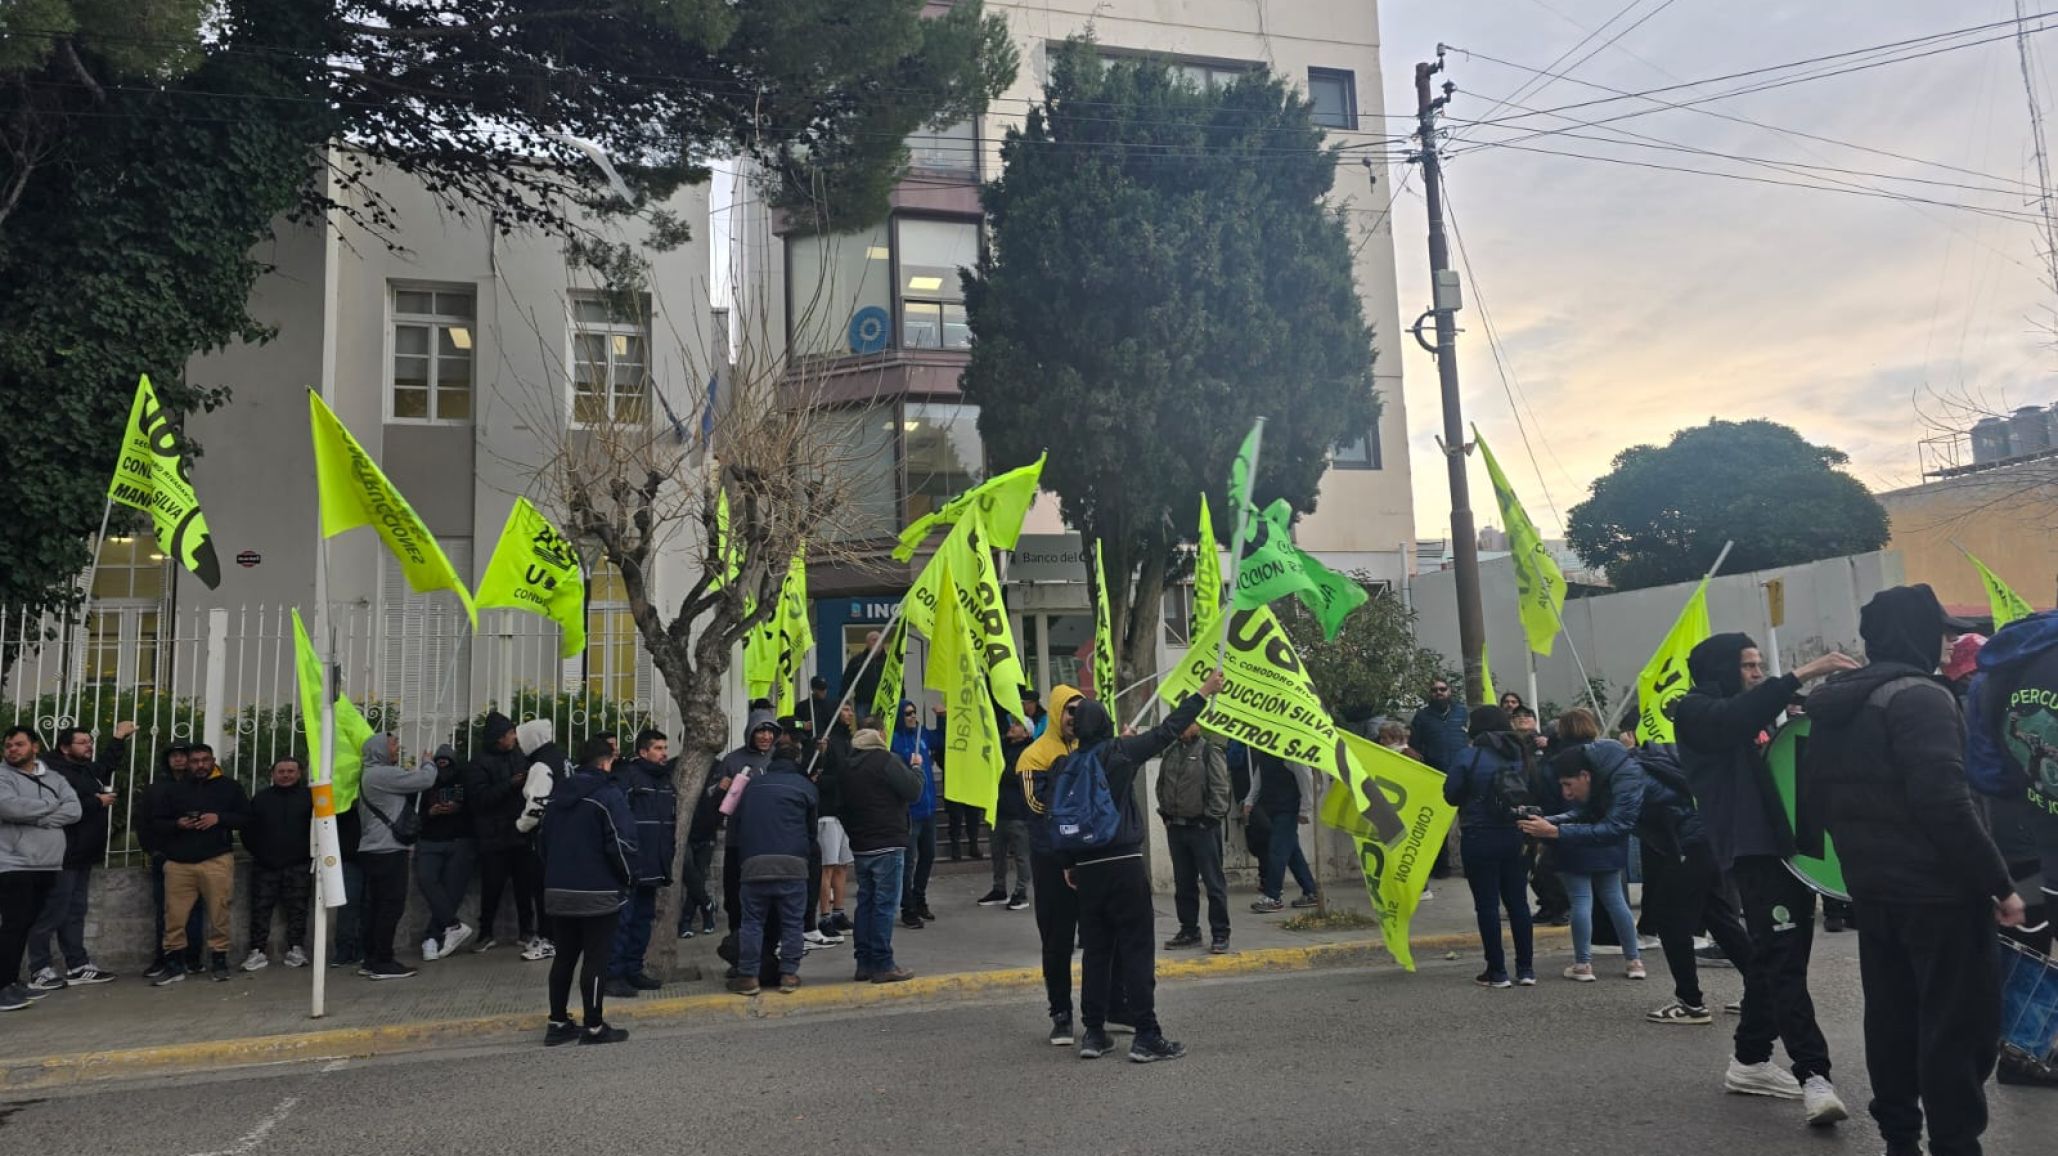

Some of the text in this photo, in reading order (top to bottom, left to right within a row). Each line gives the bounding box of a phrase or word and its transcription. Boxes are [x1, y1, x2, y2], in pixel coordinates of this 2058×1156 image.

[153, 490, 183, 519] SILVA
[1023, 552, 1058, 563] Banco
[1060, 552, 1077, 563] del
[1191, 660, 1334, 739] CODUCCIÓN SILVA
[1285, 739, 1321, 763] S.A.
